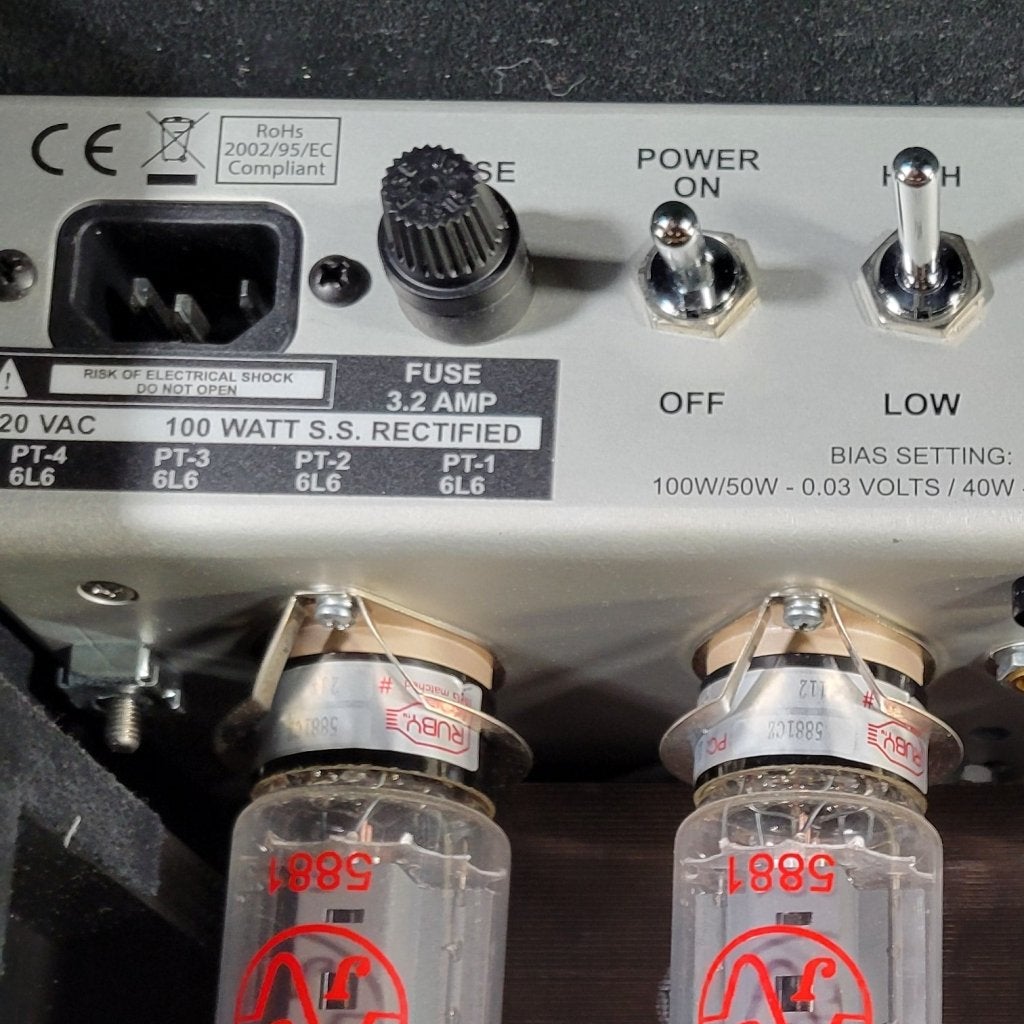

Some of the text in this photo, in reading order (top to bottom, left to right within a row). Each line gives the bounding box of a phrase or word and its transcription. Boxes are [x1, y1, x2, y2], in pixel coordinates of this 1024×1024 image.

[256, 124, 304, 140] RoHs
[225, 141, 334, 160] 2002/95/EC
[637, 148, 761, 171] POWER
[228, 160, 326, 179] Compliant
[882, 165, 961, 187] HH
[674, 177, 721, 198] ON
[84, 368, 294, 384] RISK OF ELECTRICAL SHOCK
[406, 363, 482, 385] FUSE
[137, 383, 238, 396] DO NOT OPEN
[387, 390, 498, 413] 3.2 AMP
[659, 392, 726, 415] OFF
[884, 393, 961, 416] LOW
[40, 414, 97, 435] VAC
[166, 417, 522, 444] 100 WATT S.S. RECTIFIED
[10, 444, 68, 464] PT-4
[154, 448, 211, 468] PT-3
[295, 450, 351, 471] PT-2
[442, 453, 496, 474] PT-1
[831, 446, 1013, 466] BIAS SETTING:
[8, 466, 56, 486] 6L6
[153, 469, 200, 490] 6L6
[295, 472, 342, 493] 6L6
[439, 475, 487, 496] 6L6
[653, 477, 779, 496] 100W/50W
[802, 477, 851, 496] 0.03
[860, 477, 941, 496] VOLTS
[962, 477, 1018, 496] 40W
[406, 714, 464, 745] RUBY
[884, 732, 924, 767] RUBY
[267, 853, 373, 894] 5881
[728, 853, 836, 896] 5881
